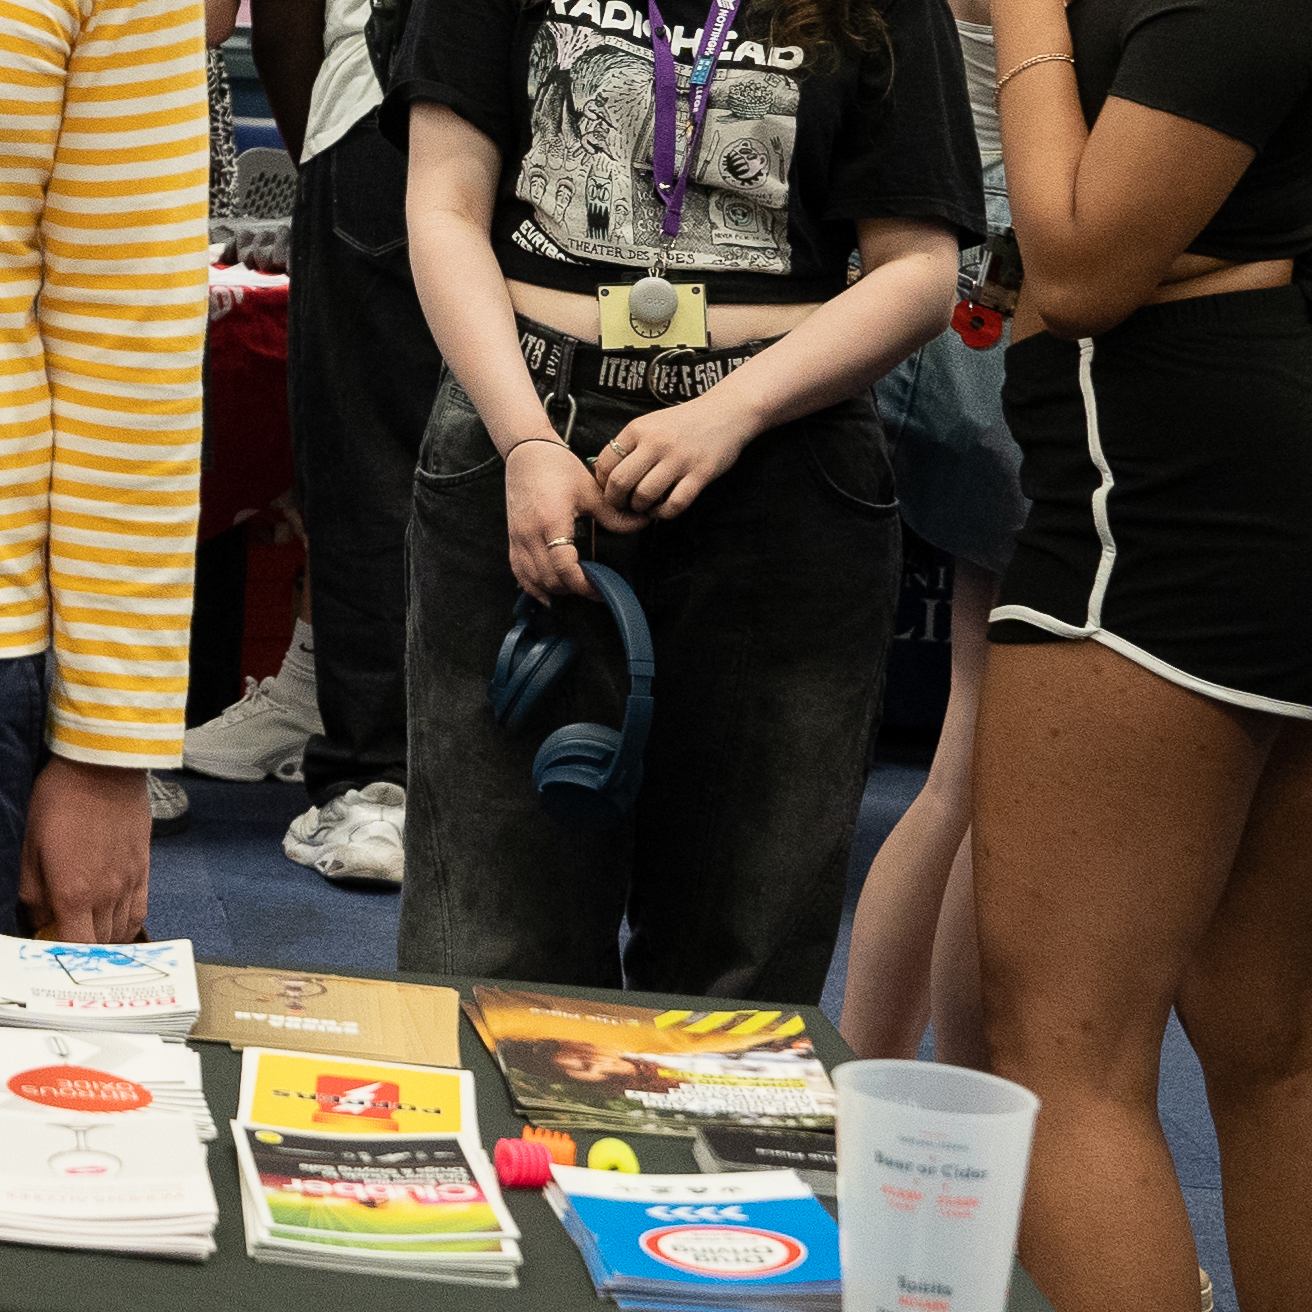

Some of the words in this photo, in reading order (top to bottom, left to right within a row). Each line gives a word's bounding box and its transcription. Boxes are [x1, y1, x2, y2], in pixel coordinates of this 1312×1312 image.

[519, 220, 576, 265] EVRYBO
[568, 238, 626, 260] THEATER
[628, 249, 650, 261] DES
[56, 997, 176, 1009] BOOZE
[56, 1078, 134, 1090] OXIDE
[20, 1084, 139, 1101] NITROUS
[672, 1244, 774, 1255] Driving
[693, 1253, 765, 1264] Drug
